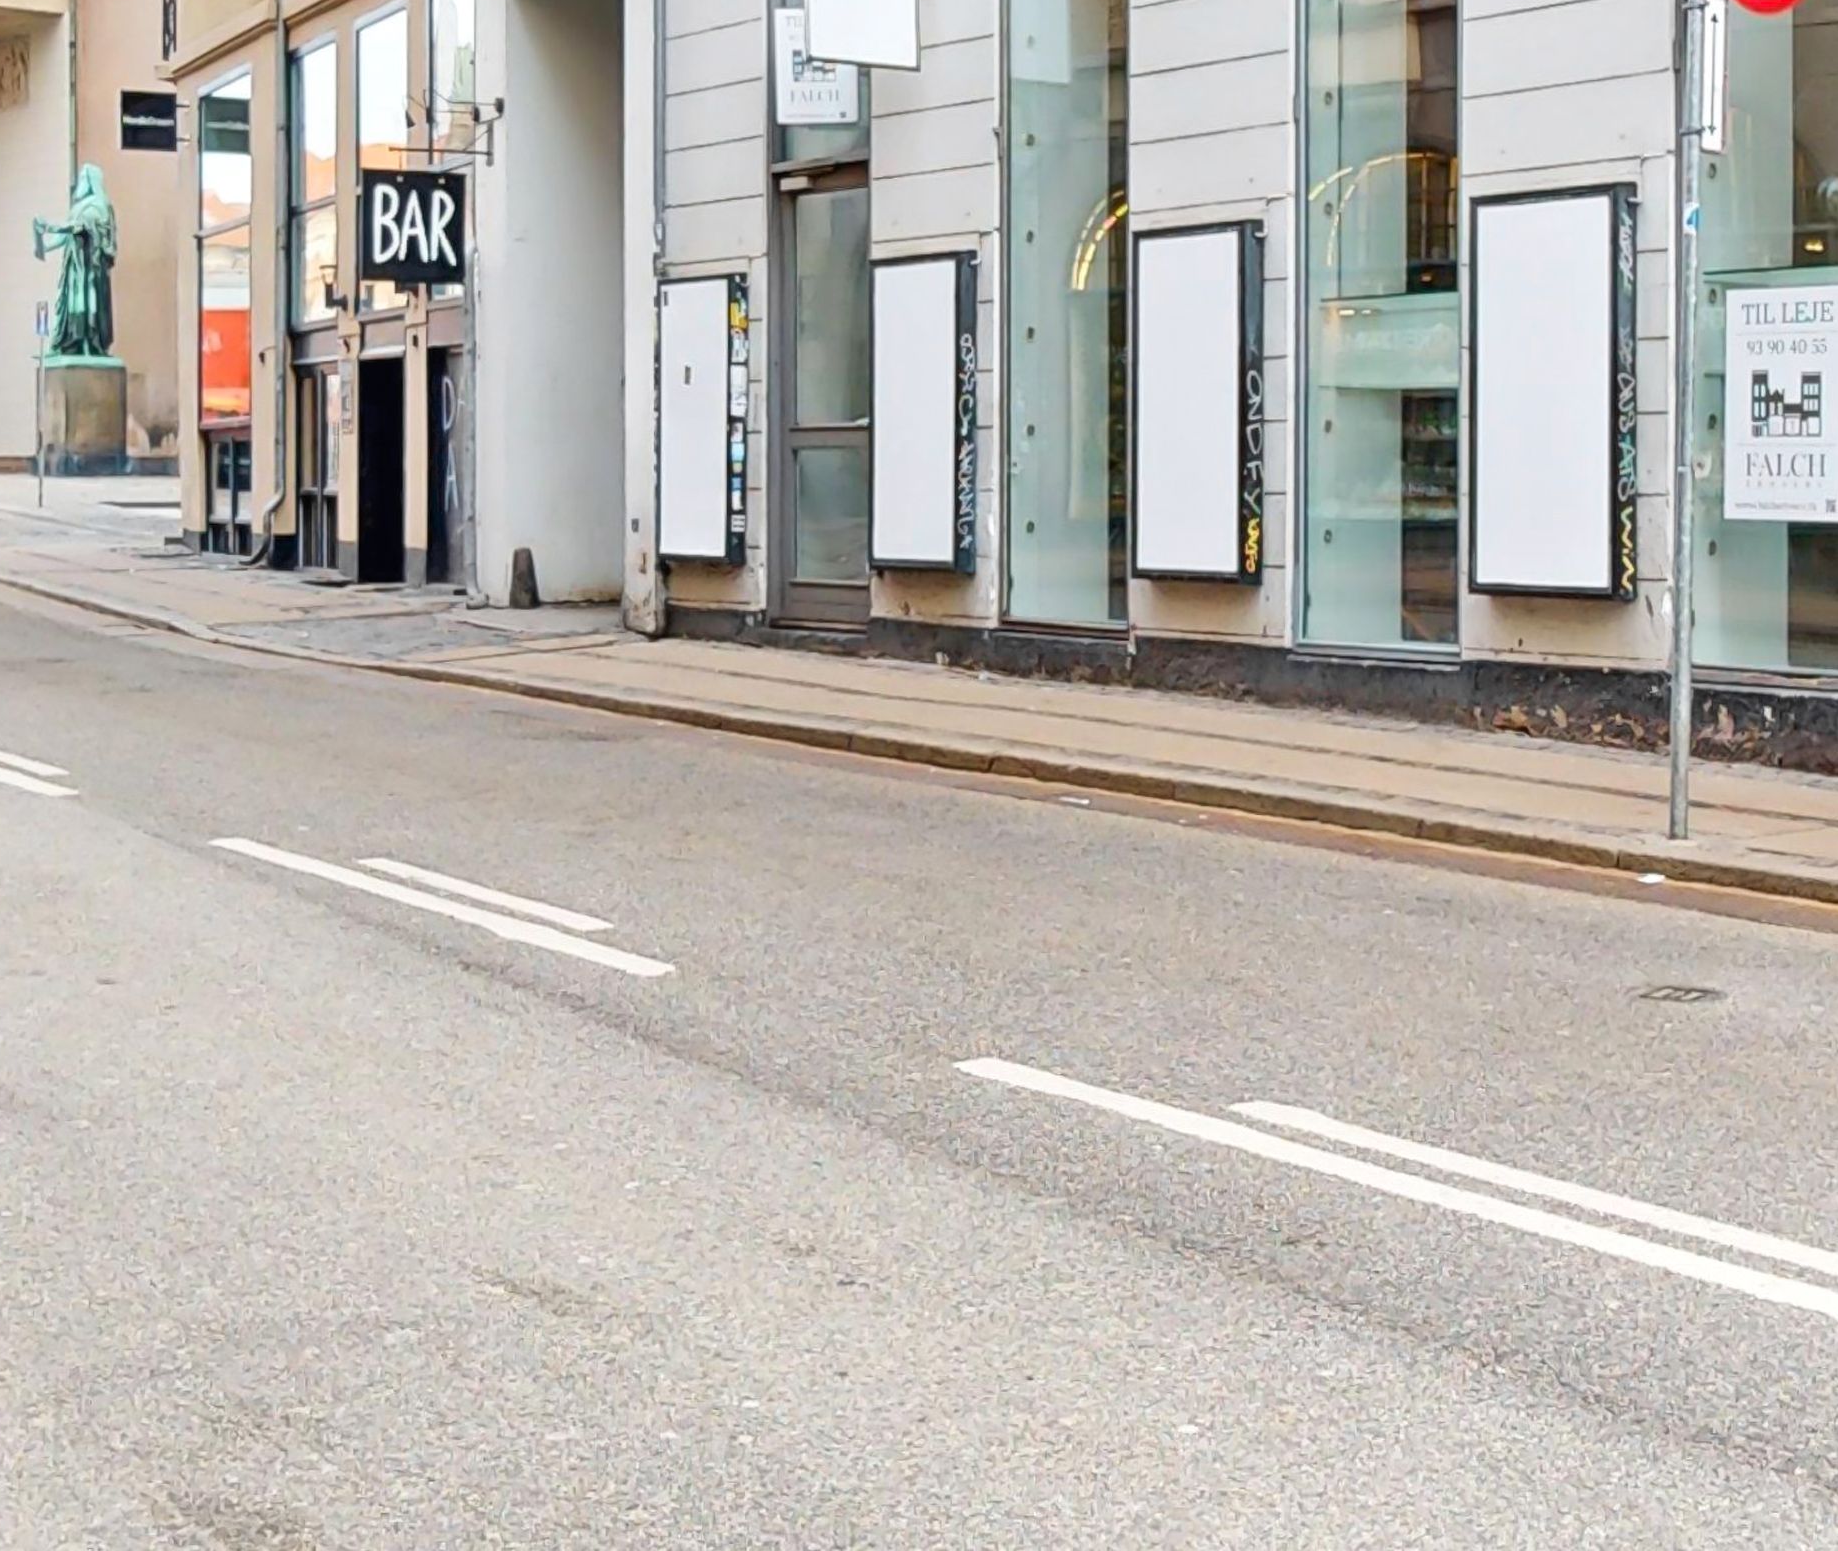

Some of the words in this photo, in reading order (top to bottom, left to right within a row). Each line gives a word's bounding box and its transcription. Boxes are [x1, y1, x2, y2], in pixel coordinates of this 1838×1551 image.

[372, 183, 458, 266] BAR
[1741, 303, 1776, 325] TIL
[1781, 301, 1835, 323] LEJE
[1746, 340, 1763, 355] 93
[1767, 339, 1785, 355] 90
[1789, 339, 1808, 354] 40
[1811, 338, 1828, 354] 55
[1746, 453, 1826, 477] FALCH
